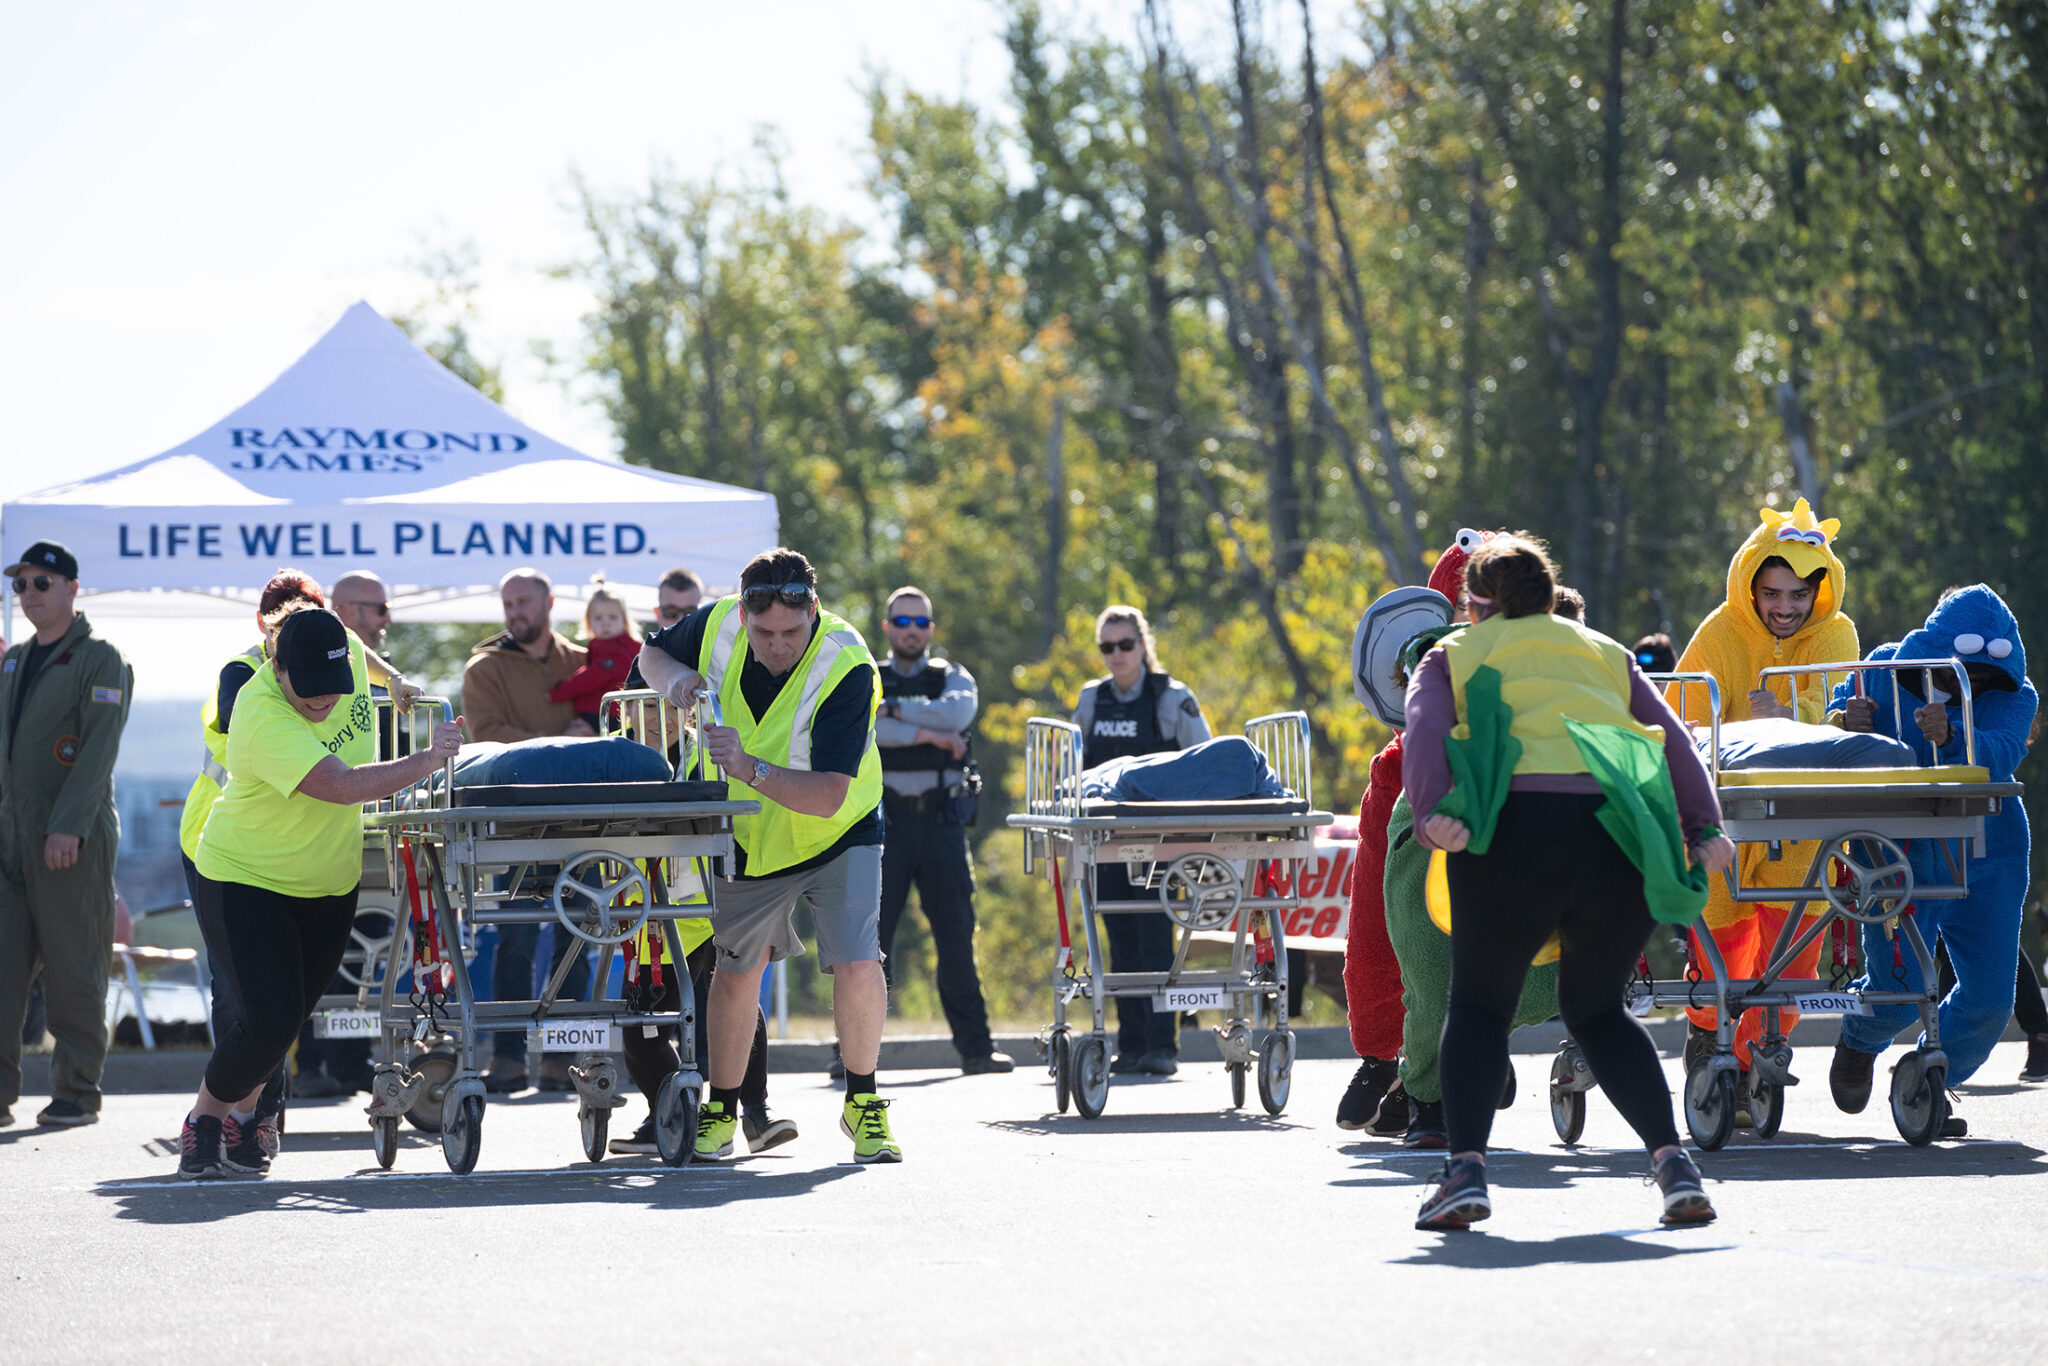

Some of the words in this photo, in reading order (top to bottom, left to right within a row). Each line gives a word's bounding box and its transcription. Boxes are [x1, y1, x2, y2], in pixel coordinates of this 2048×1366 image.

[229, 428, 529, 453] RAYMOND
[119, 523, 222, 557] LIFE
[240, 522, 376, 556] WELL
[393, 522, 657, 555] PLANNED.
[1093, 720, 1138, 737] POLICE
[1169, 993, 1219, 1005] FRONT
[1800, 998, 1856, 1010] FRONT
[331, 1017, 380, 1031] FRONT
[547, 1029, 605, 1045] FRONT
